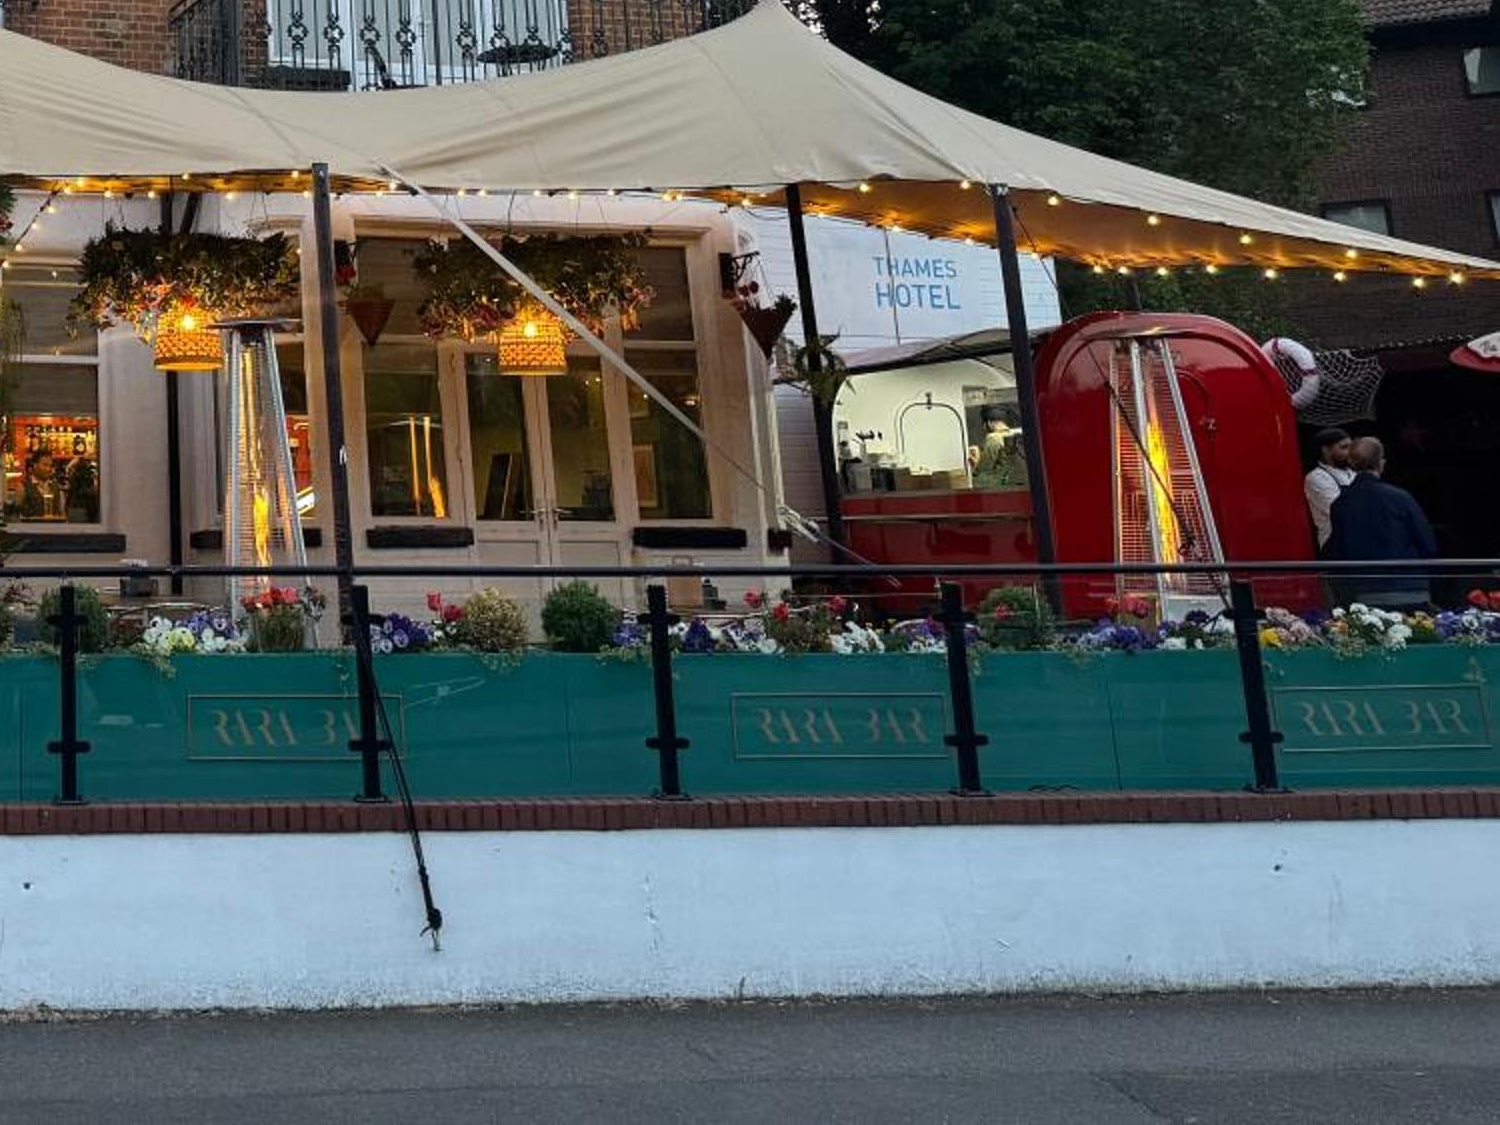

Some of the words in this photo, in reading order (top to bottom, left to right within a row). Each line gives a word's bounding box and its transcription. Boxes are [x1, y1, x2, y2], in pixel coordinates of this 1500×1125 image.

[872, 256, 957, 278] THAMES
[875, 283, 961, 309] HOTEL
[211, 708, 298, 747] RARA
[316, 709, 361, 746] BA
[756, 707, 844, 745] RARA
[1295, 700, 1386, 737] RARA
[1405, 699, 1472, 735] BAR
